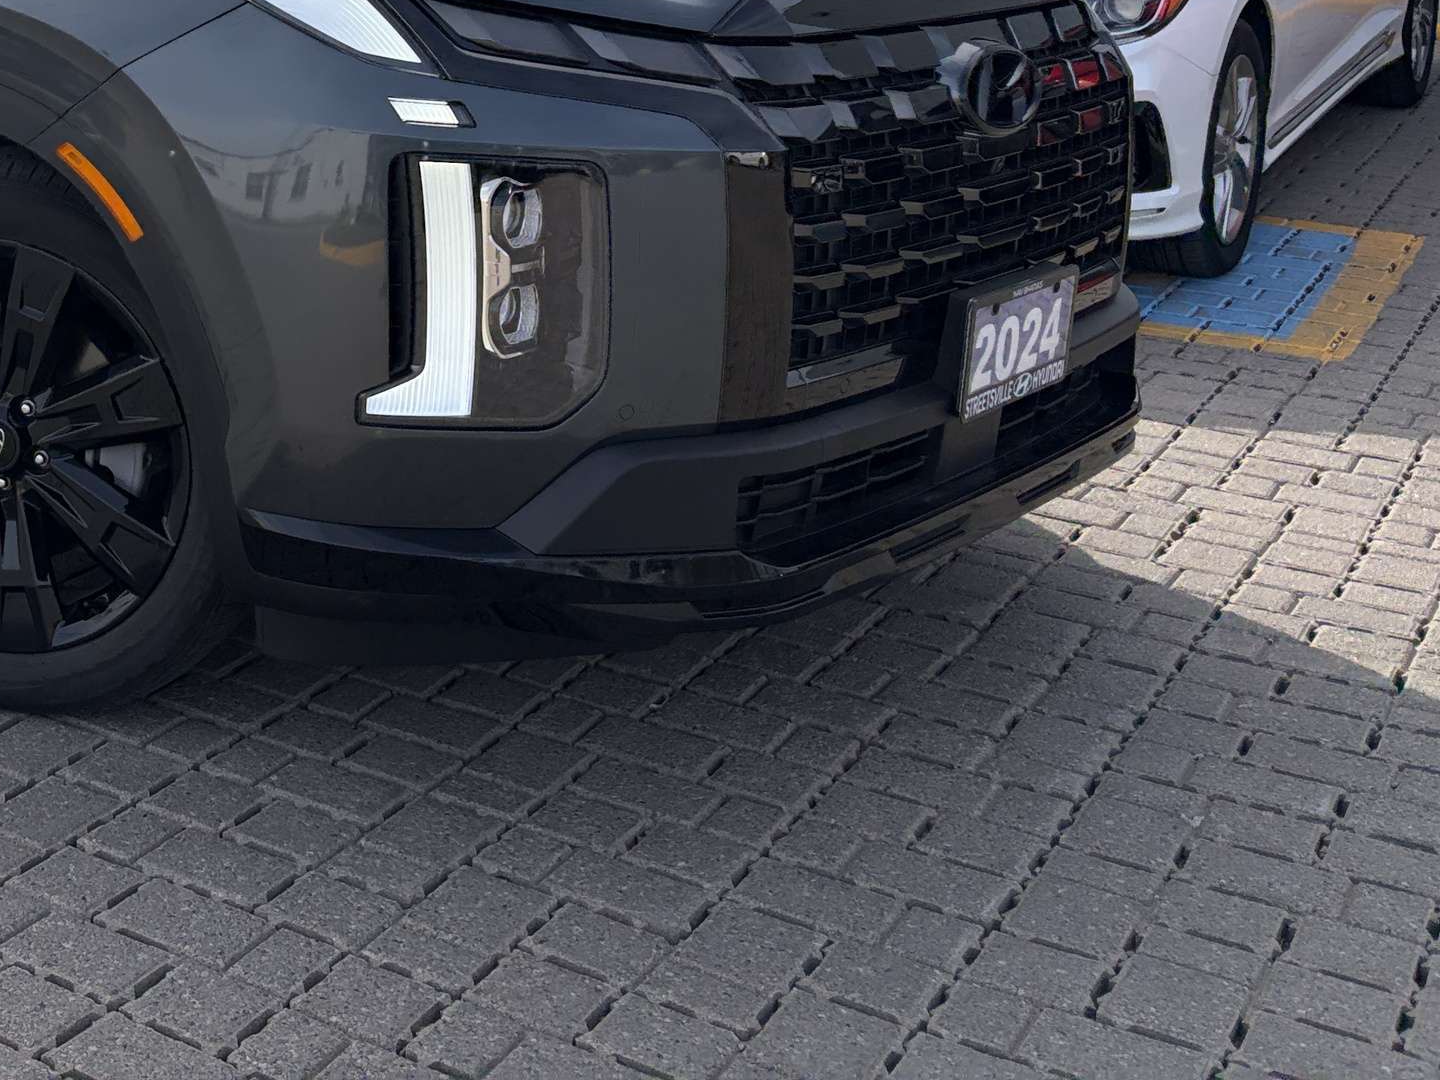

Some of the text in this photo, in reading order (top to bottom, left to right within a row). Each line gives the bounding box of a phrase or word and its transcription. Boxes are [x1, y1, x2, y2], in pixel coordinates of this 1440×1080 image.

[970, 297, 1063, 395] 2024
[964, 360, 1065, 419] STREETSVILLE HYUNDAI
